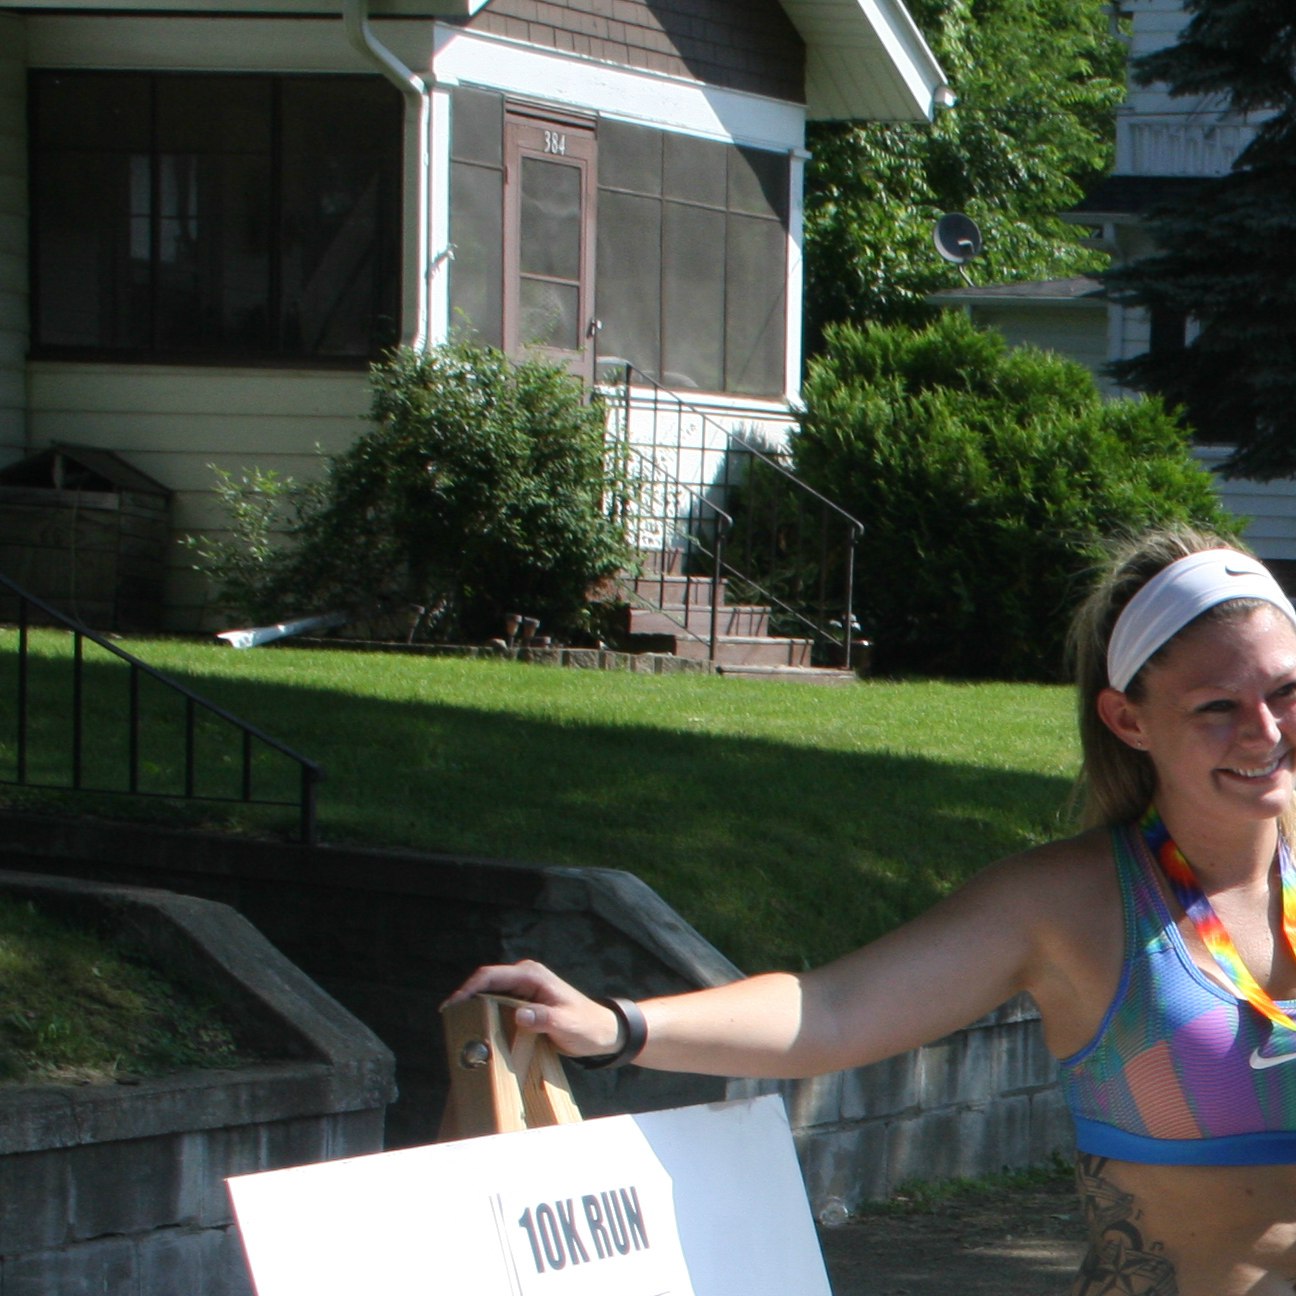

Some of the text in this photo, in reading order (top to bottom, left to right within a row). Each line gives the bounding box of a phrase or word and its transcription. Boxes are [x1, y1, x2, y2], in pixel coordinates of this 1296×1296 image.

[543, 130, 566, 156] 384
[518, 1185, 650, 1274] 10K RUN
